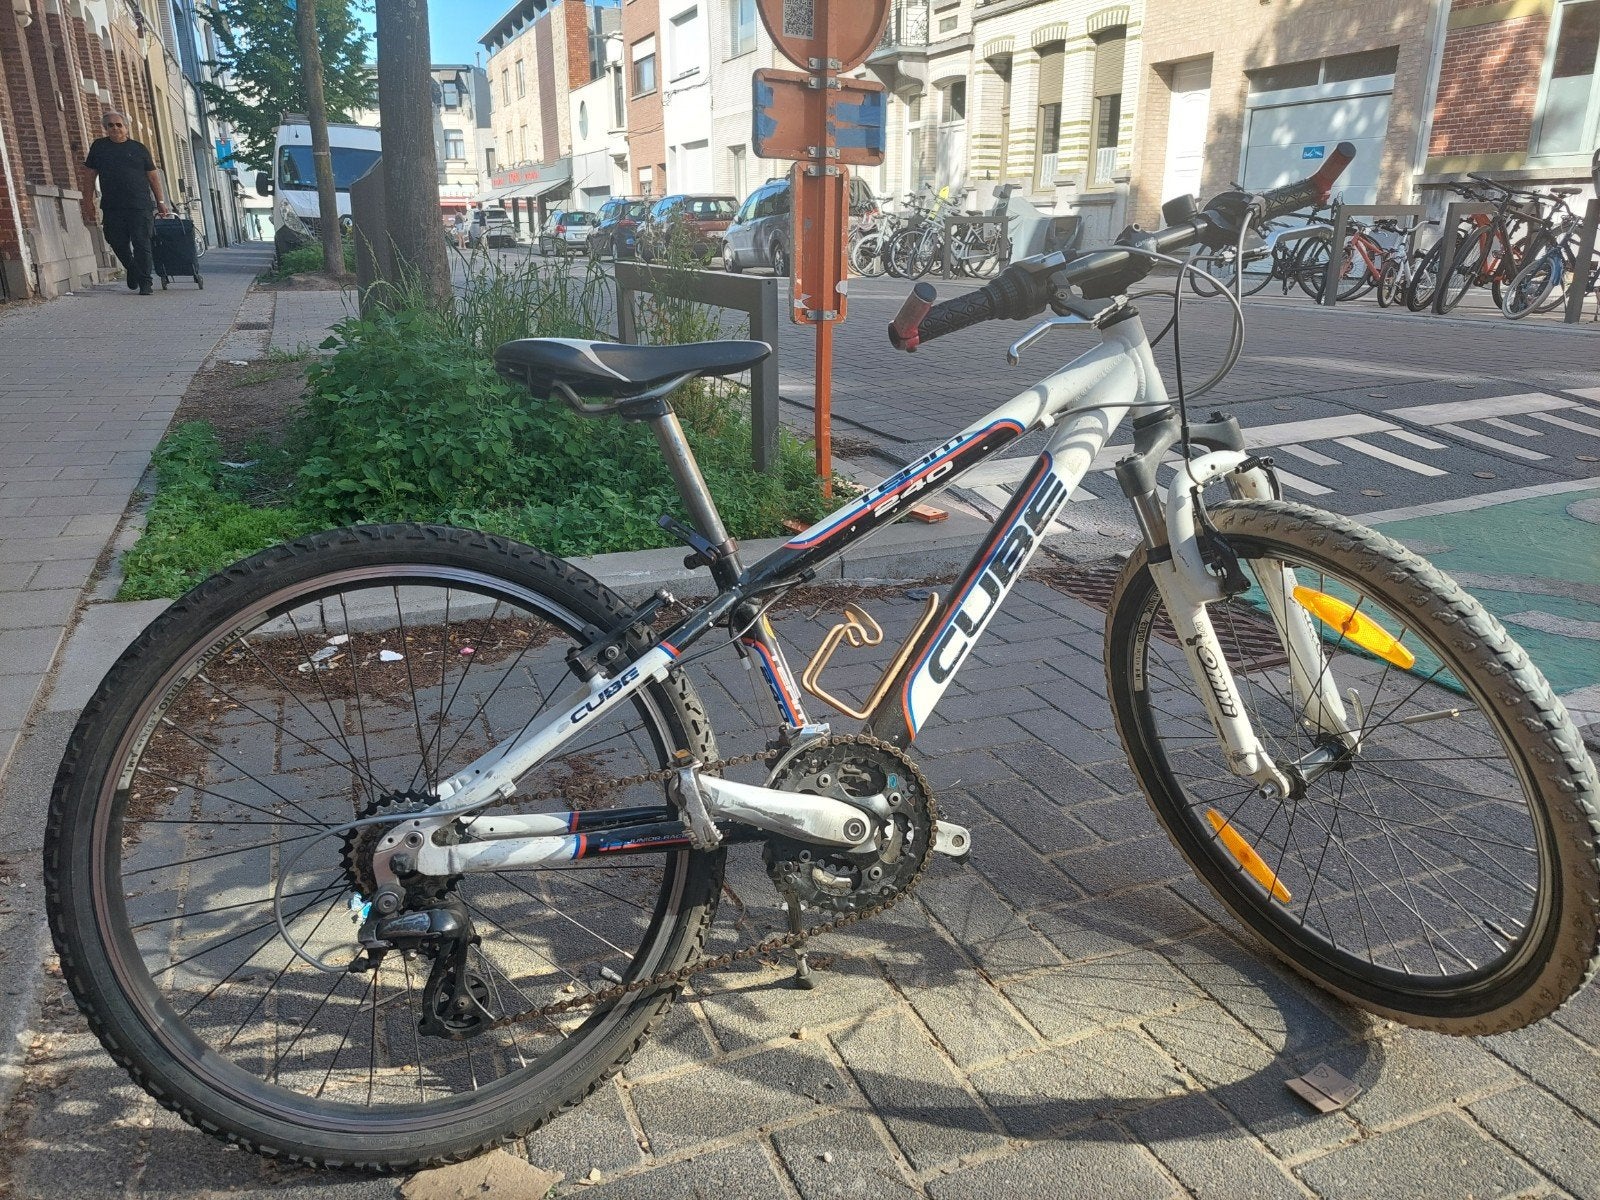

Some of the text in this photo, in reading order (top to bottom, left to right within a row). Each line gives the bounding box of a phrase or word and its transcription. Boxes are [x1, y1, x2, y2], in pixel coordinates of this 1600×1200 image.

[873, 460, 954, 518] 240
[927, 472, 1068, 685] CUBE
[570, 666, 640, 724] CUBE
